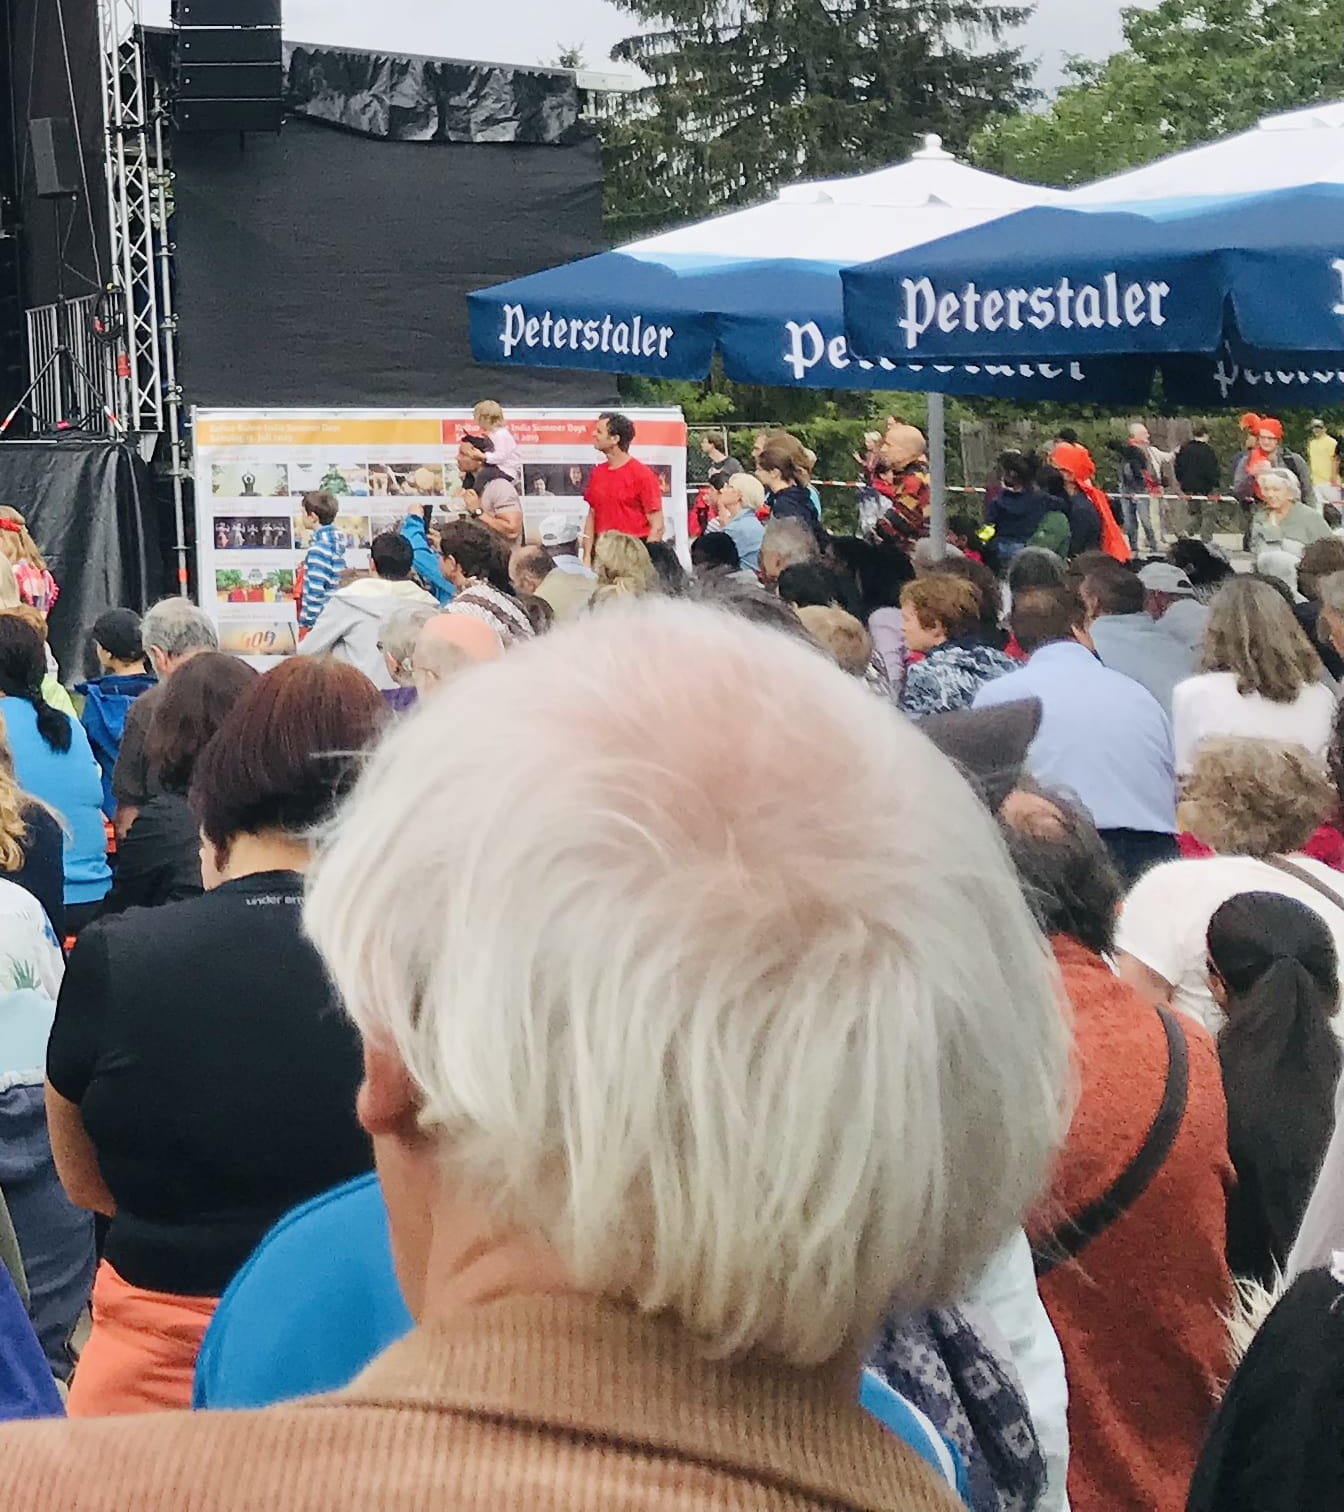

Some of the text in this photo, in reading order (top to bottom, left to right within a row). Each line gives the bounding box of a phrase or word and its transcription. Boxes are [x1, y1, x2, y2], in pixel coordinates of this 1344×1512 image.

[499, 304, 674, 358] Peterstaler
[898, 272, 1171, 349] Peterstaler
[246, 895, 281, 905] under
